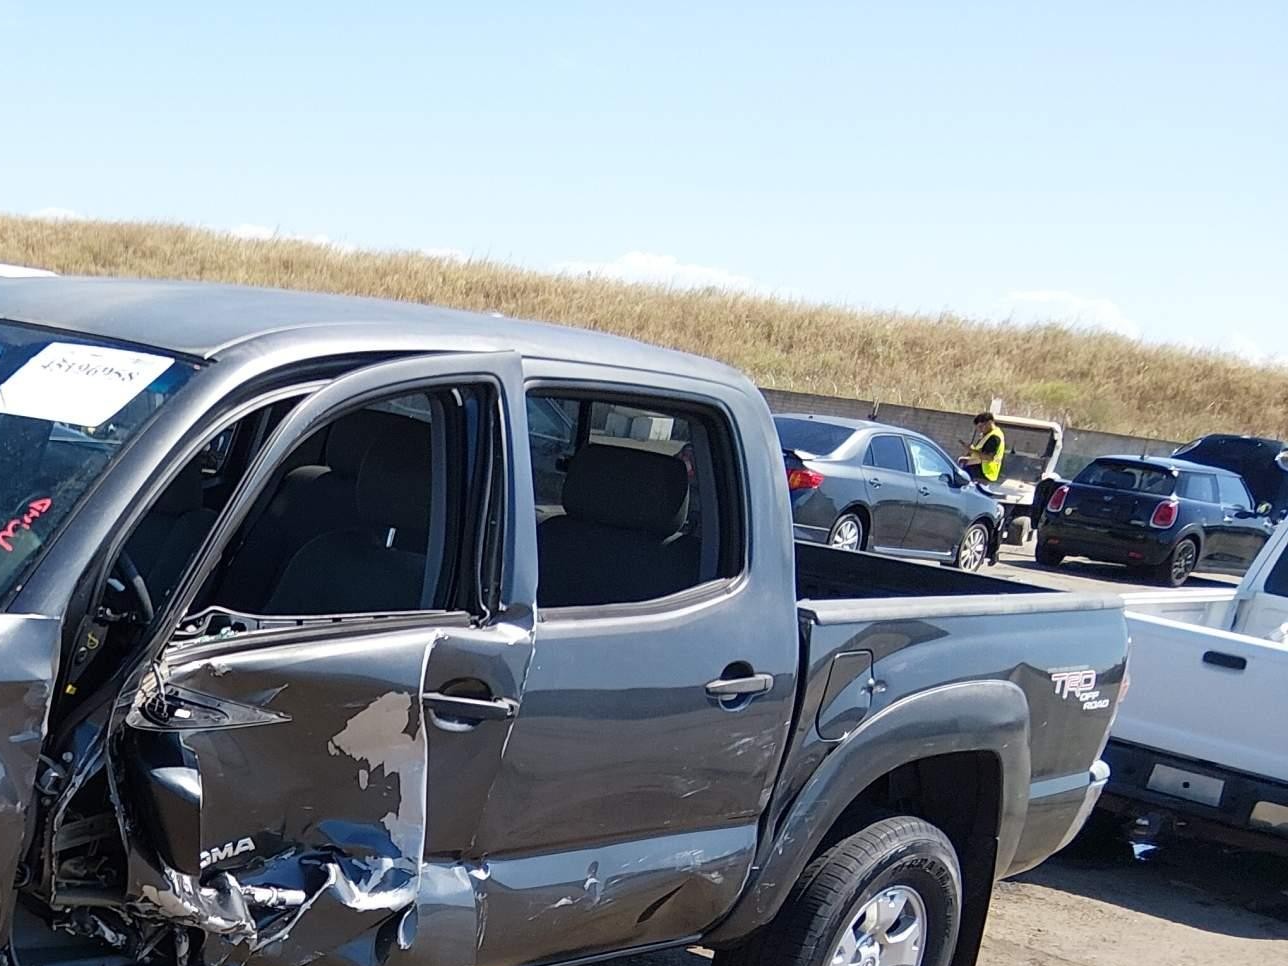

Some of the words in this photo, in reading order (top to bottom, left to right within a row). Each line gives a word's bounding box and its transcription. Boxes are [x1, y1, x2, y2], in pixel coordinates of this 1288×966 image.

[1051, 670, 1096, 699] TRD
[1079, 690, 1100, 702] OFF
[1082, 699, 1110, 710] ROAD
[200, 837, 255, 870] OMA
